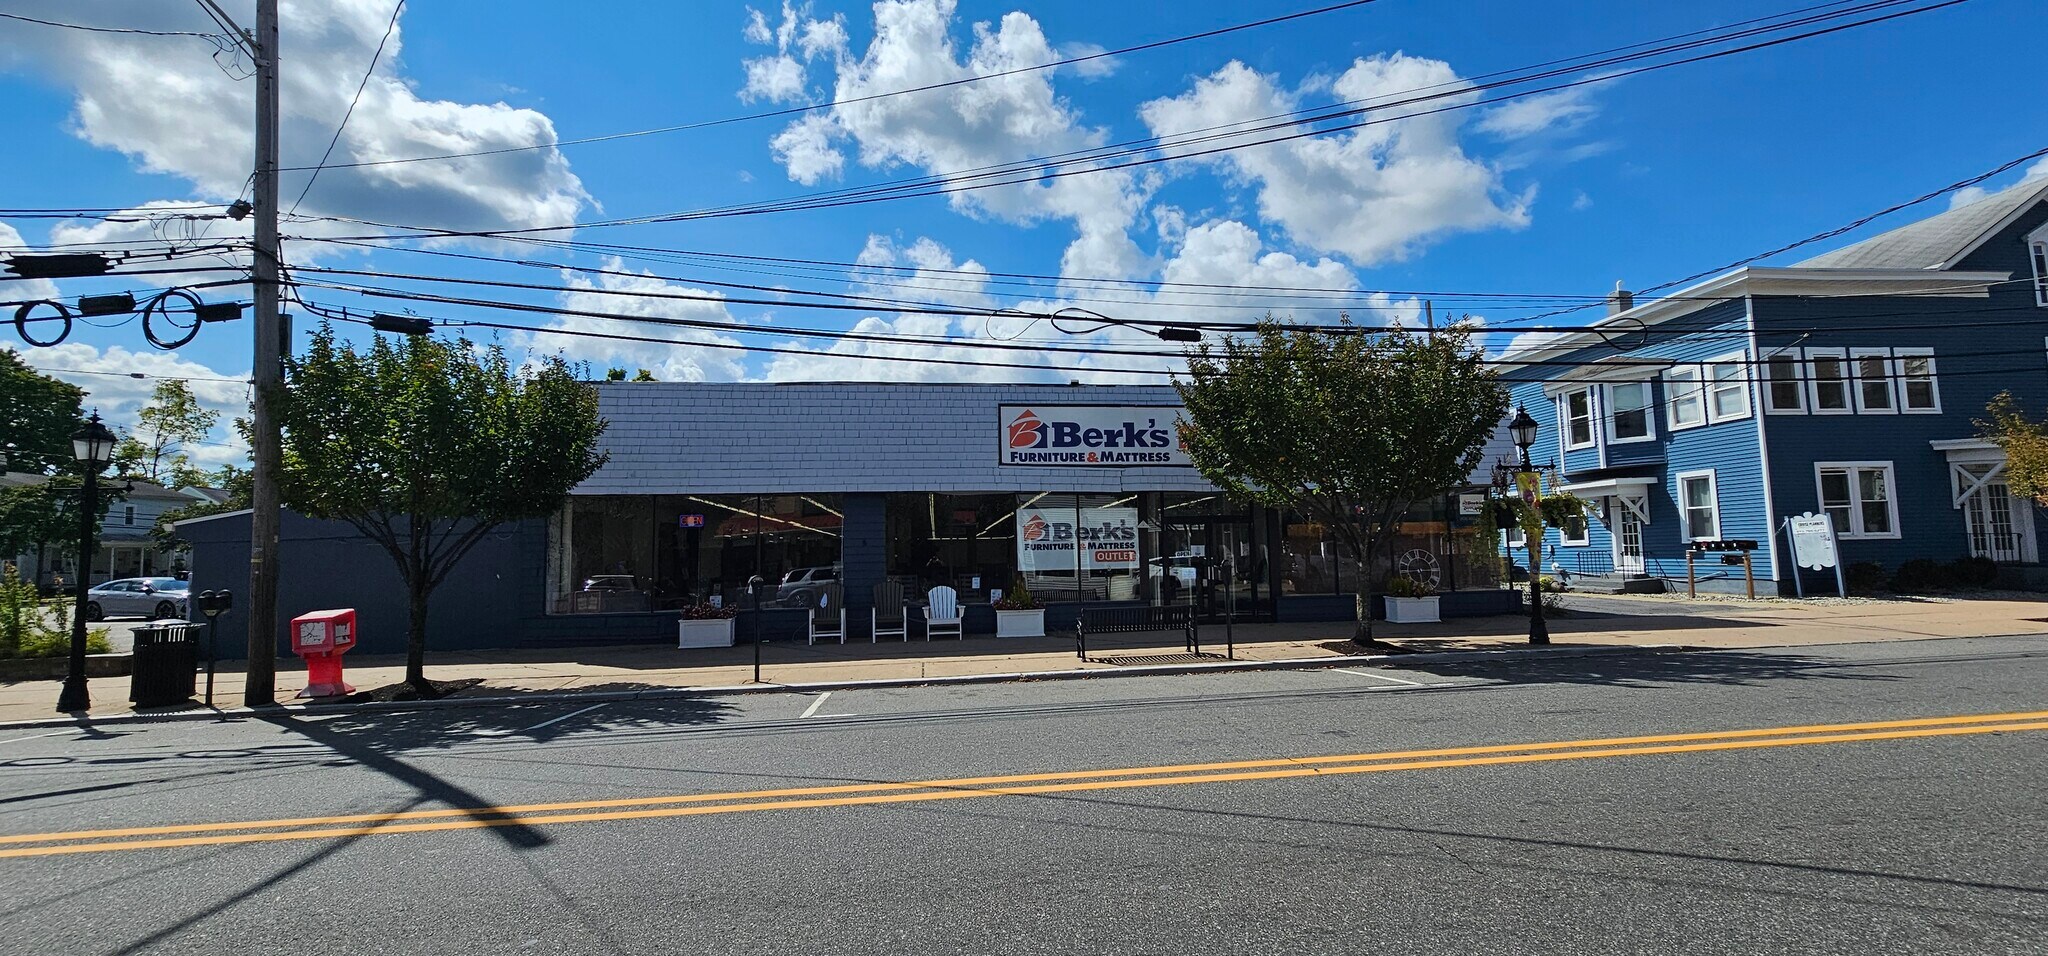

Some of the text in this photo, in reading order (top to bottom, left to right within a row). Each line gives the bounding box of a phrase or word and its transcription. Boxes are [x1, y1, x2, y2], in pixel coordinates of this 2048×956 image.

[1051, 418, 1170, 448] Berk's
[1010, 451, 1170, 463] FURNITURE & MATTRESS
[1051, 518, 1136, 542] Berk's
[1024, 543, 1075, 551] FURNITURE
[1087, 542, 1135, 550] MATTRESS
[1097, 551, 1135, 561] OUTLET
